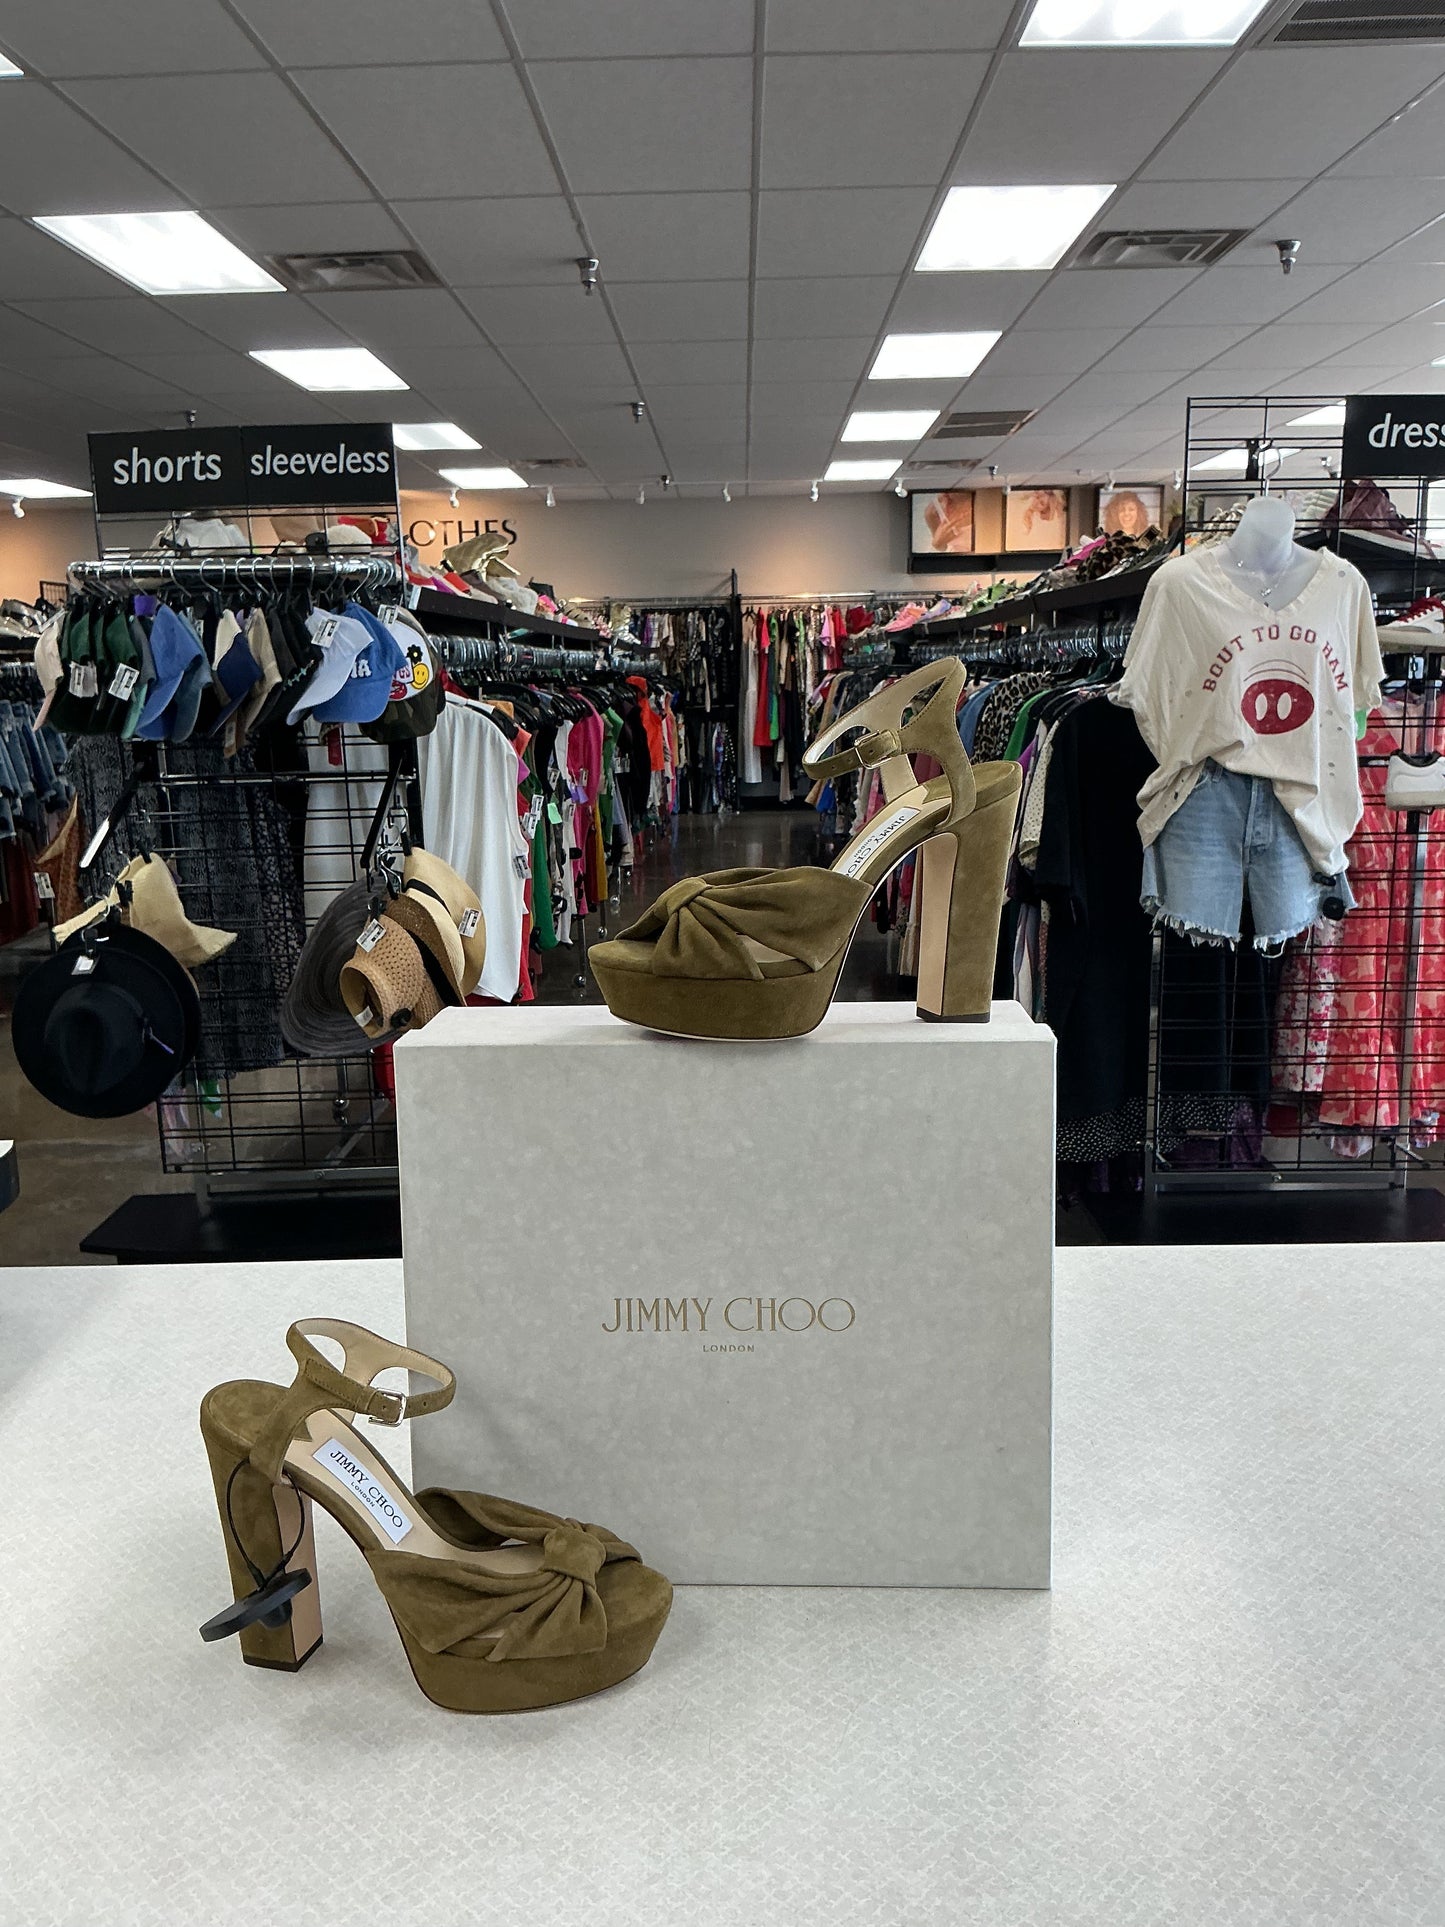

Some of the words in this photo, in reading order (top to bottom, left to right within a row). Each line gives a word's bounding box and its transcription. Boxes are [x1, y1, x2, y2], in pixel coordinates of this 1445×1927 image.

[113, 447, 222, 485] shorts
[250, 443, 390, 476] sleeveless
[1202, 635, 1244, 693] BOUT
[1252, 624, 1280, 642] TO
[1289, 625, 1317, 644] GO
[1322, 641, 1349, 692] HAM
[873, 815, 906, 844] JIMMY
[853, 835, 876, 858] LONDON
[601, 1297, 713, 1333] JIMMY
[724, 1297, 856, 1332] CHOO
[702, 1344, 755, 1353] LONDON
[330, 1450, 370, 1485] JIMMY
[368, 1486, 403, 1528] CHOO
[350, 1481, 375, 1507] LONDON
